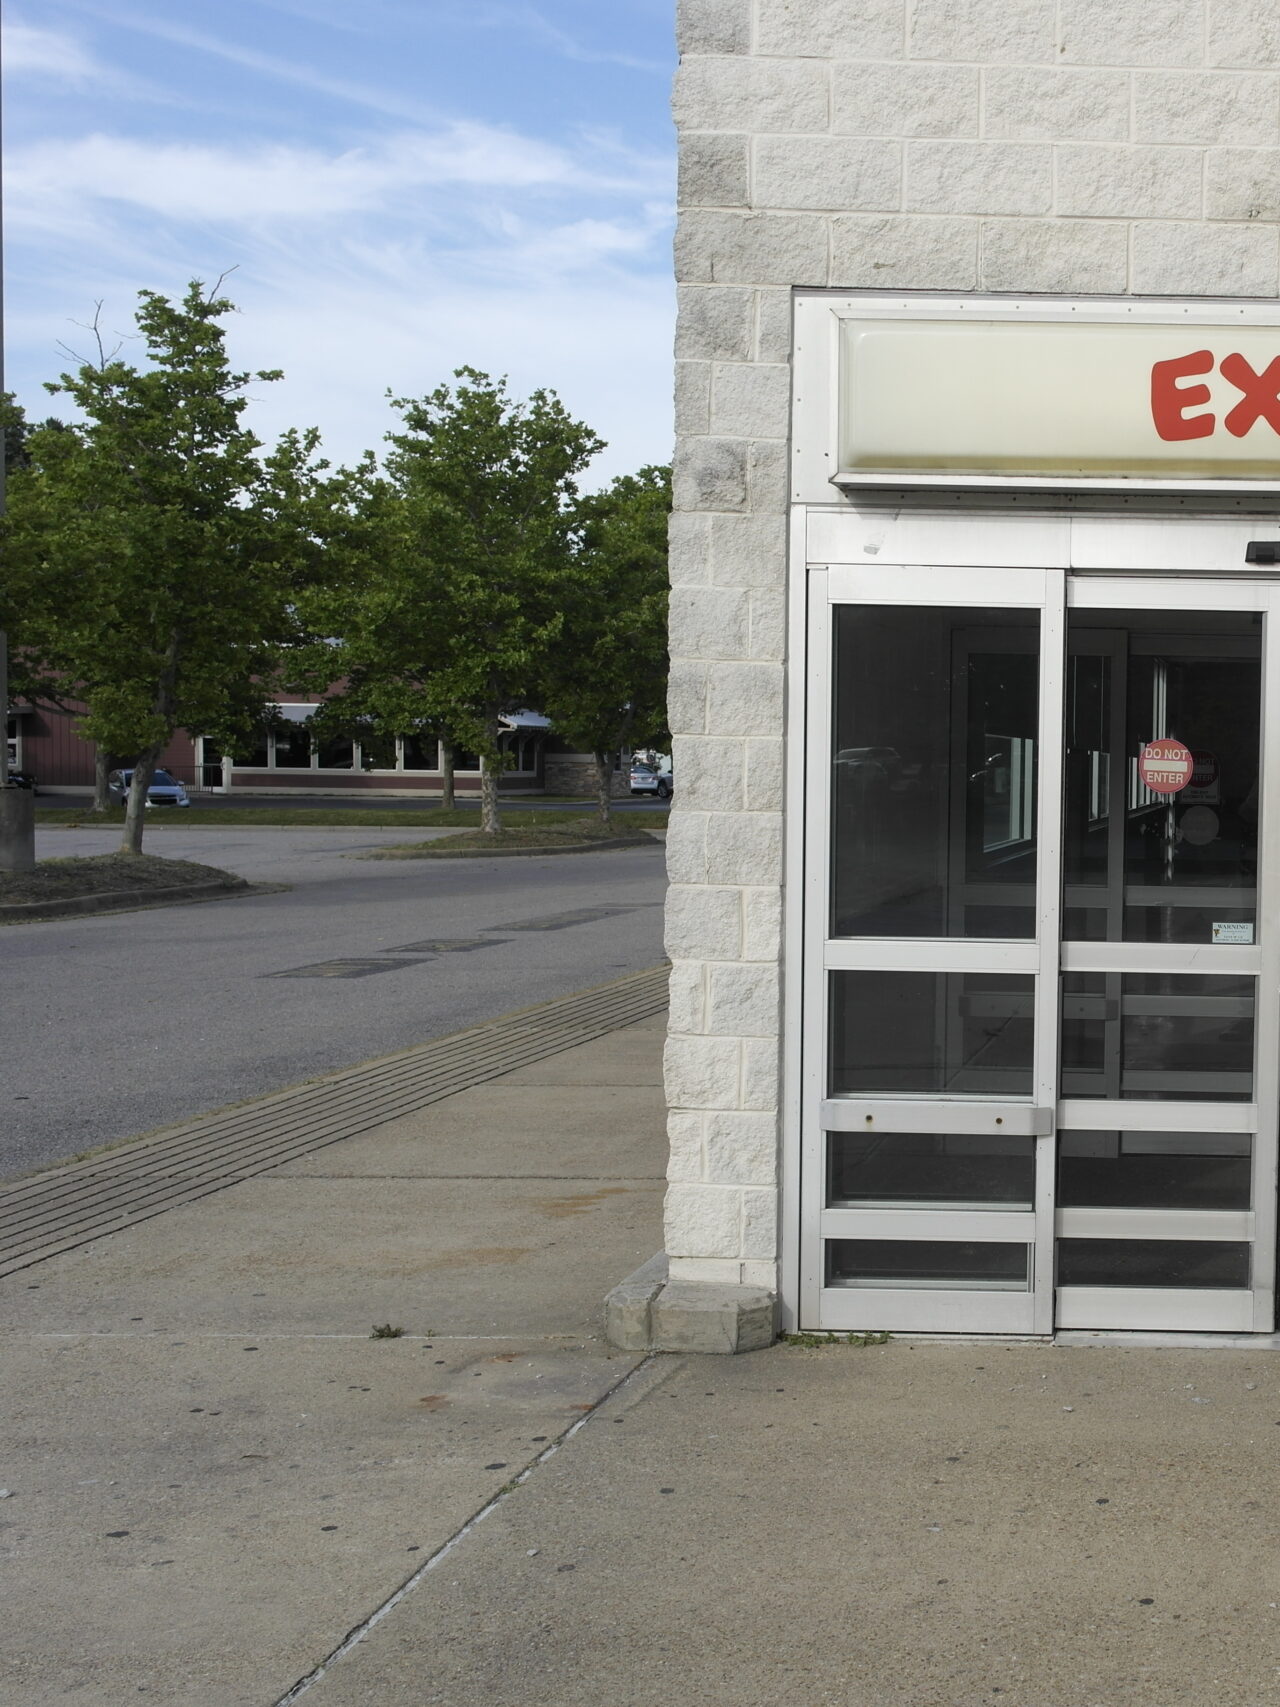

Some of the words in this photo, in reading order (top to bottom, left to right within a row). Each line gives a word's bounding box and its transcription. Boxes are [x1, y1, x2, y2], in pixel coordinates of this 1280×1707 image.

[1145, 748, 1162, 759] DO
[1164, 749, 1188, 760] NOT
[1147, 772, 1184, 784] ENTER
